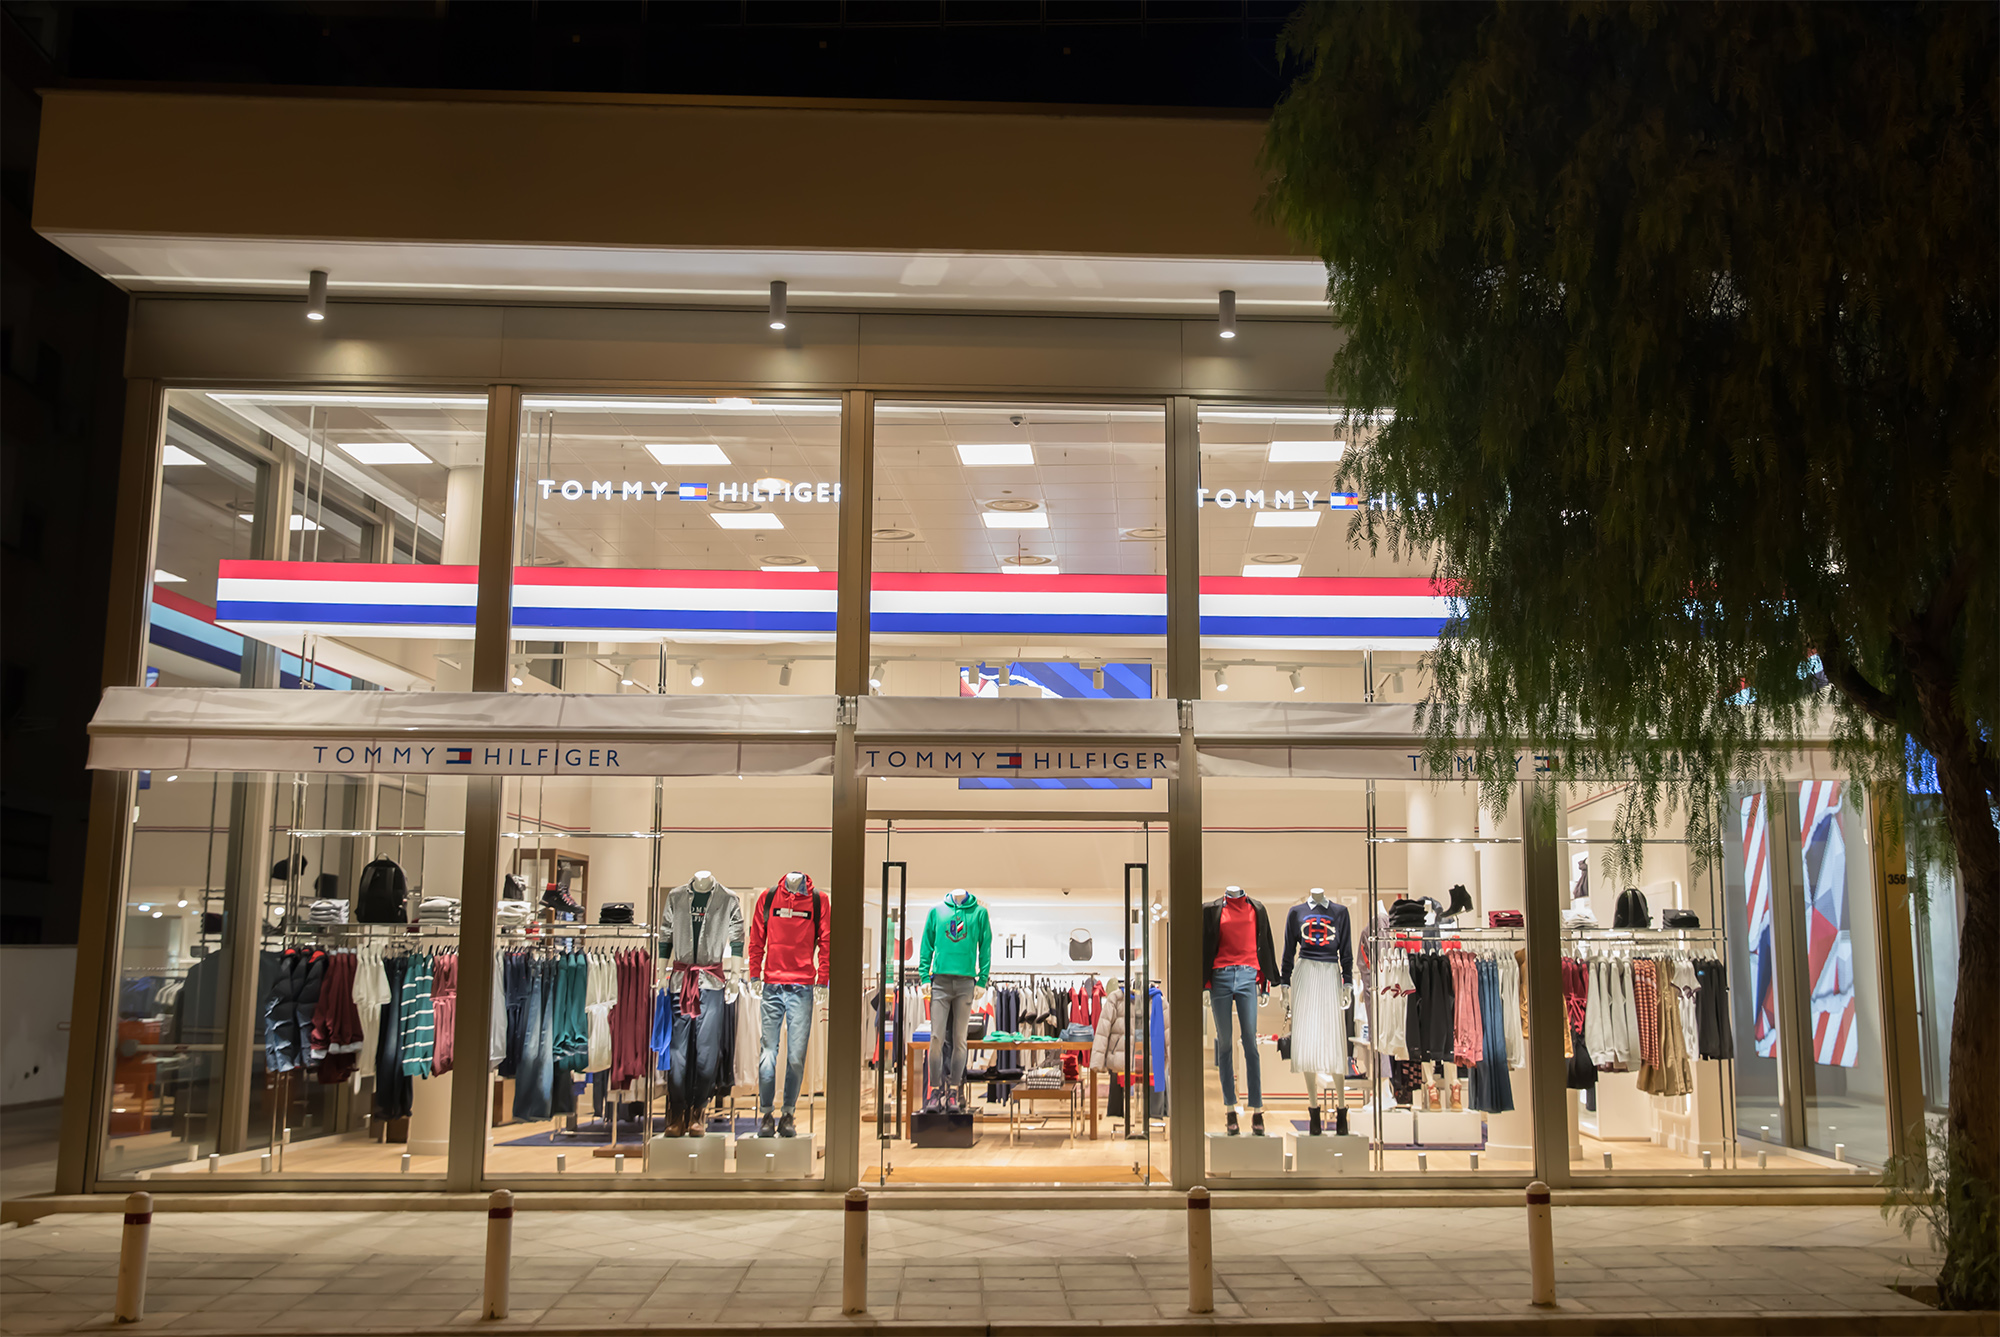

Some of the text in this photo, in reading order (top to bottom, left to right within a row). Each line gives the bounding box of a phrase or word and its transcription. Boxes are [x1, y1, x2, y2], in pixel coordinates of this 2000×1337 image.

[538, 480, 669, 501] TOMMY
[1197, 488, 1320, 510] TOMMY
[313, 746, 620, 767] TOMMY HILFIGER
[866, 751, 1167, 770] TOMMY HILFIGER
[1888, 873, 1906, 885] 359
